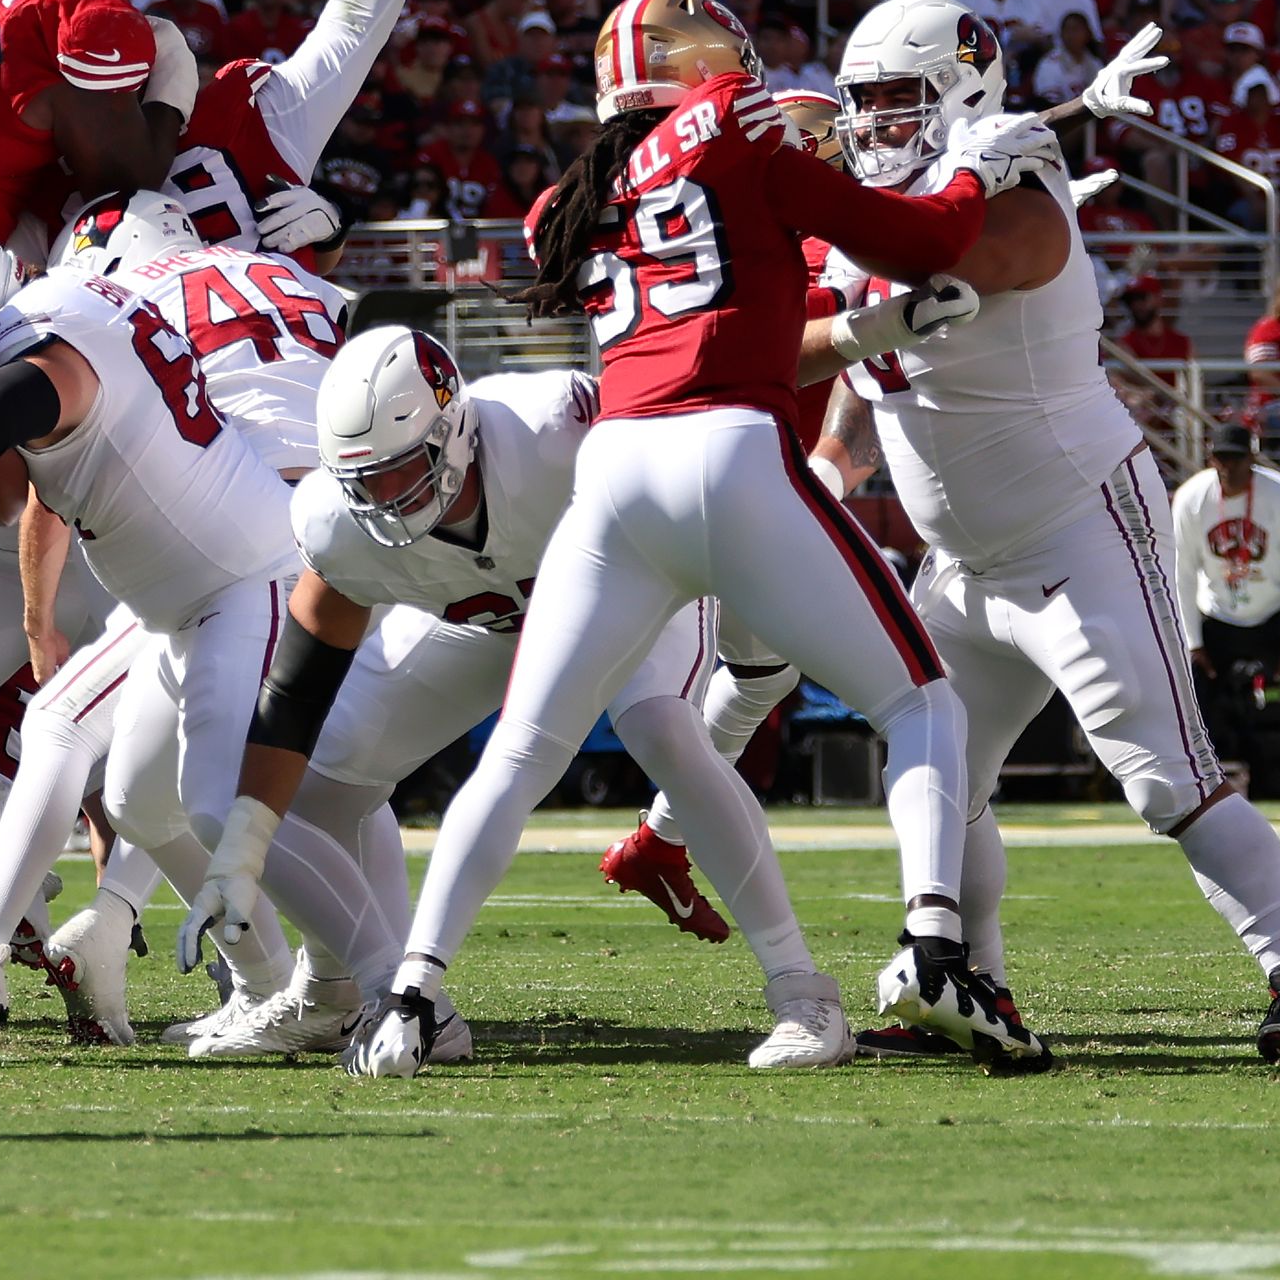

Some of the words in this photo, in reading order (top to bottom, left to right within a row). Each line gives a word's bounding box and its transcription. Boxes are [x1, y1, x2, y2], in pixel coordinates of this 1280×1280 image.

[675, 101, 721, 153] SR
[1157, 95, 1207, 138] 49
[576, 176, 728, 348] 59
[180, 263, 347, 362] 46
